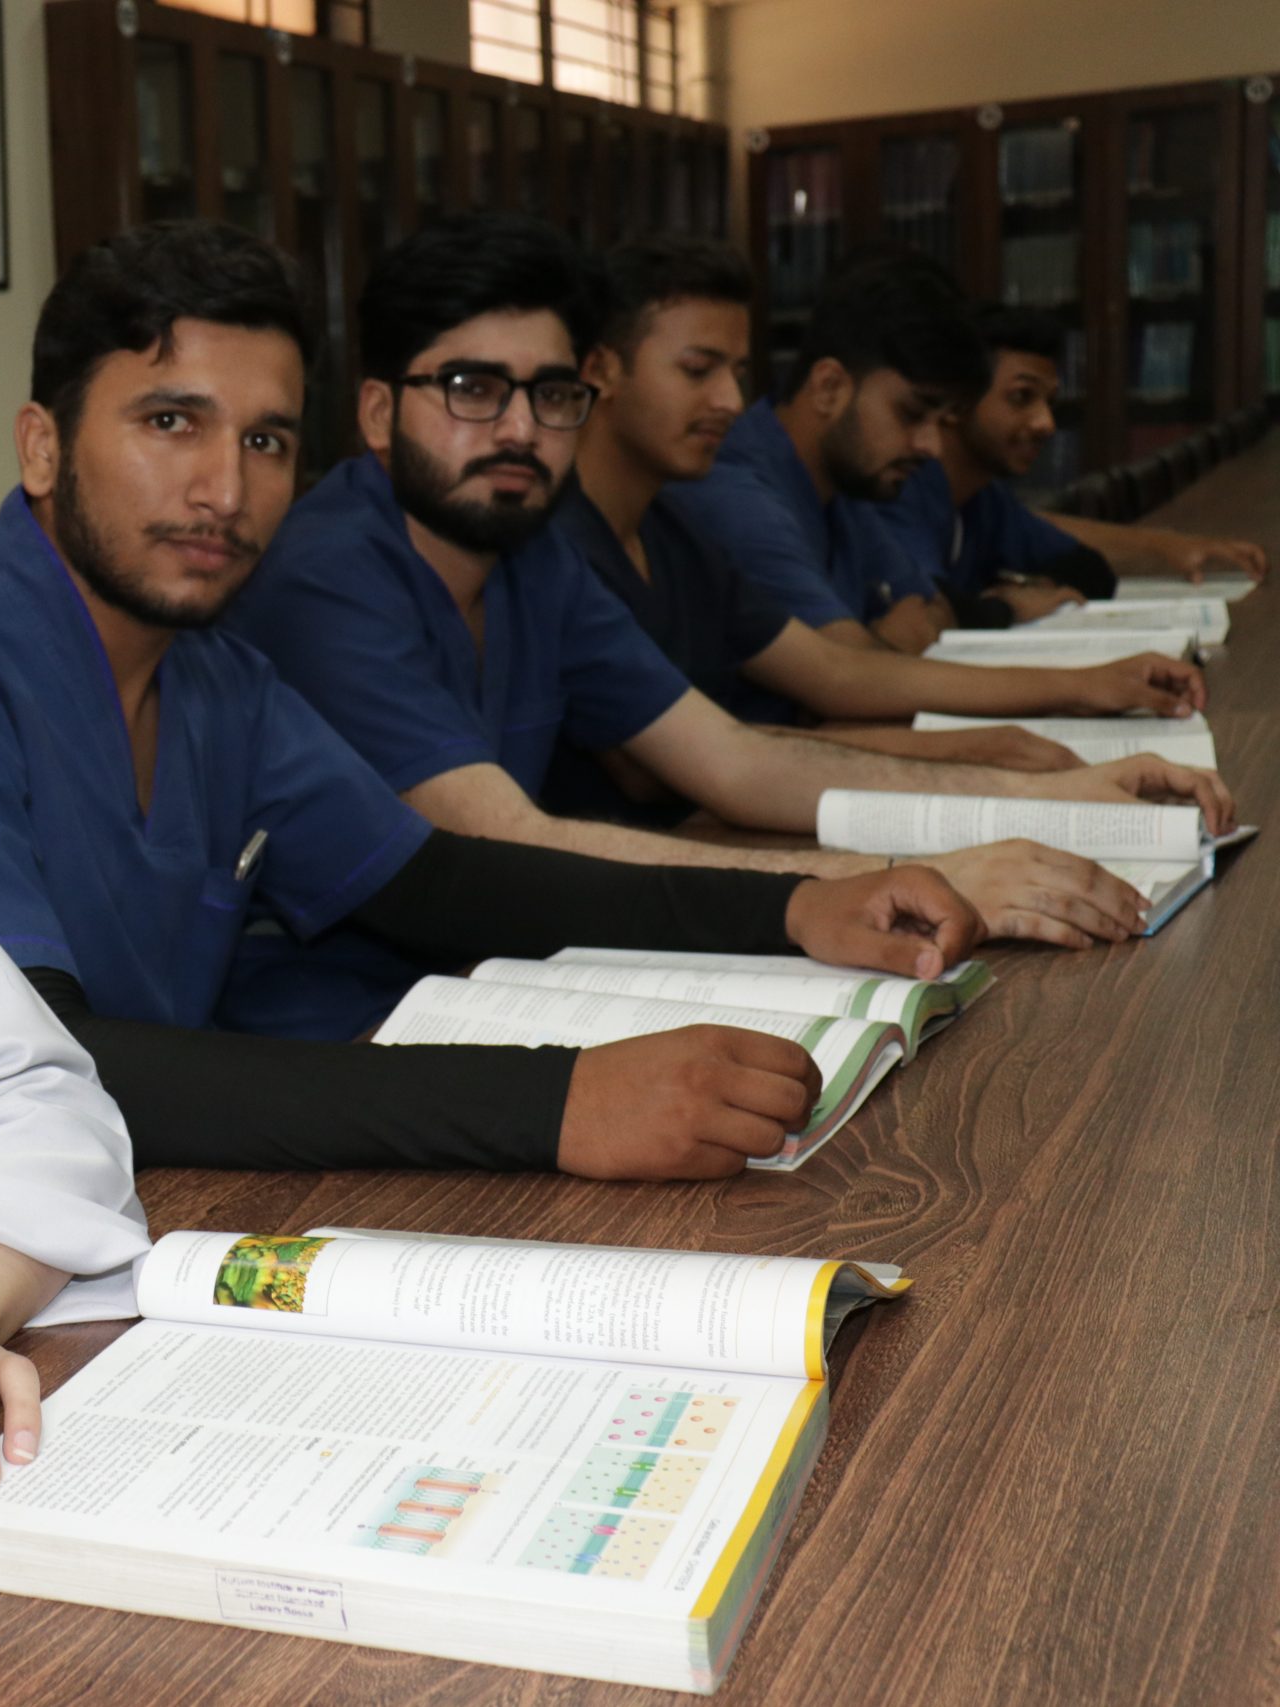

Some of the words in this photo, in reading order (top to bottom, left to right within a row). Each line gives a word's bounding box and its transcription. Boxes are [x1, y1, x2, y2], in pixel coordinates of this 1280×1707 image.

[425, 1294, 431, 1302] of
[435, 1275, 448, 1306] branched
[566, 1290, 575, 1319] surfaces
[645, 1287, 653, 1309] sugars
[500, 1291, 512, 1320] through
[544, 1290, 553, 1323] influence
[577, 1289, 585, 1323] sandwich
[597, 1294, 609, 1317] charge
[621, 1300, 630, 1318] have
[566, 1322, 572, 1330] of
[608, 1313, 616, 1347] (meaning
[631, 1310, 639, 1349] cholesterol
[651, 1320, 661, 1341] layers
[708, 1301, 718, 1341] substances
[720, 1311, 728, 1358] fundamental
[654, 1344, 661, 1352] of
